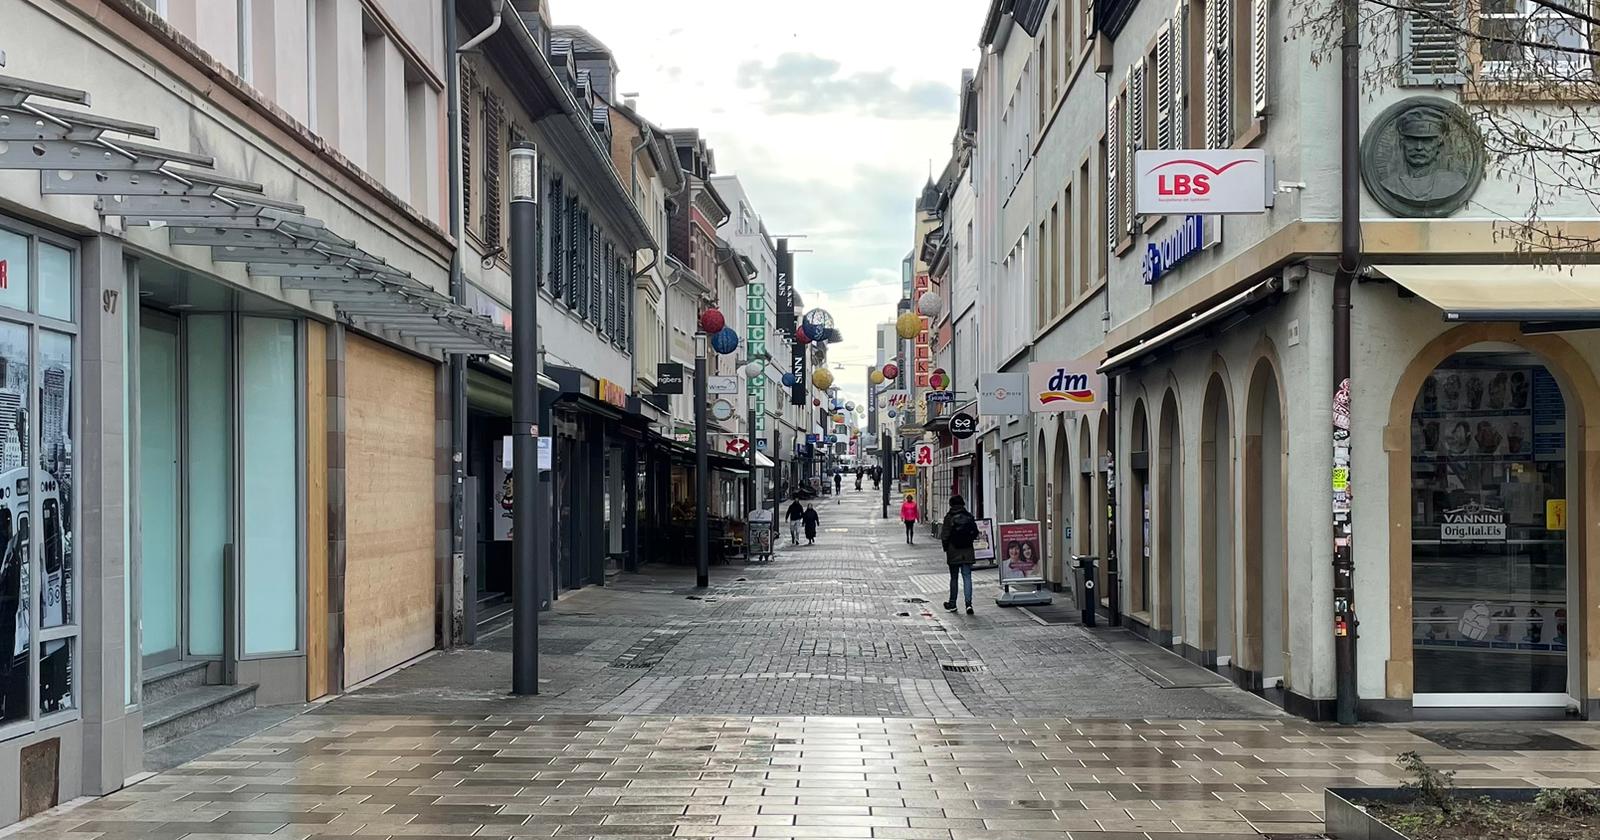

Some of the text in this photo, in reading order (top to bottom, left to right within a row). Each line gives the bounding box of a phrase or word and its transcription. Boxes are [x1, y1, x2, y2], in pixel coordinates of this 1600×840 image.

[1158, 174, 1210, 195] LBS
[103, 289, 119, 314] 97
[794, 357, 803, 384] SINN
[1048, 369, 1087, 391] dm
[1444, 514, 1503, 523] VANNINI
